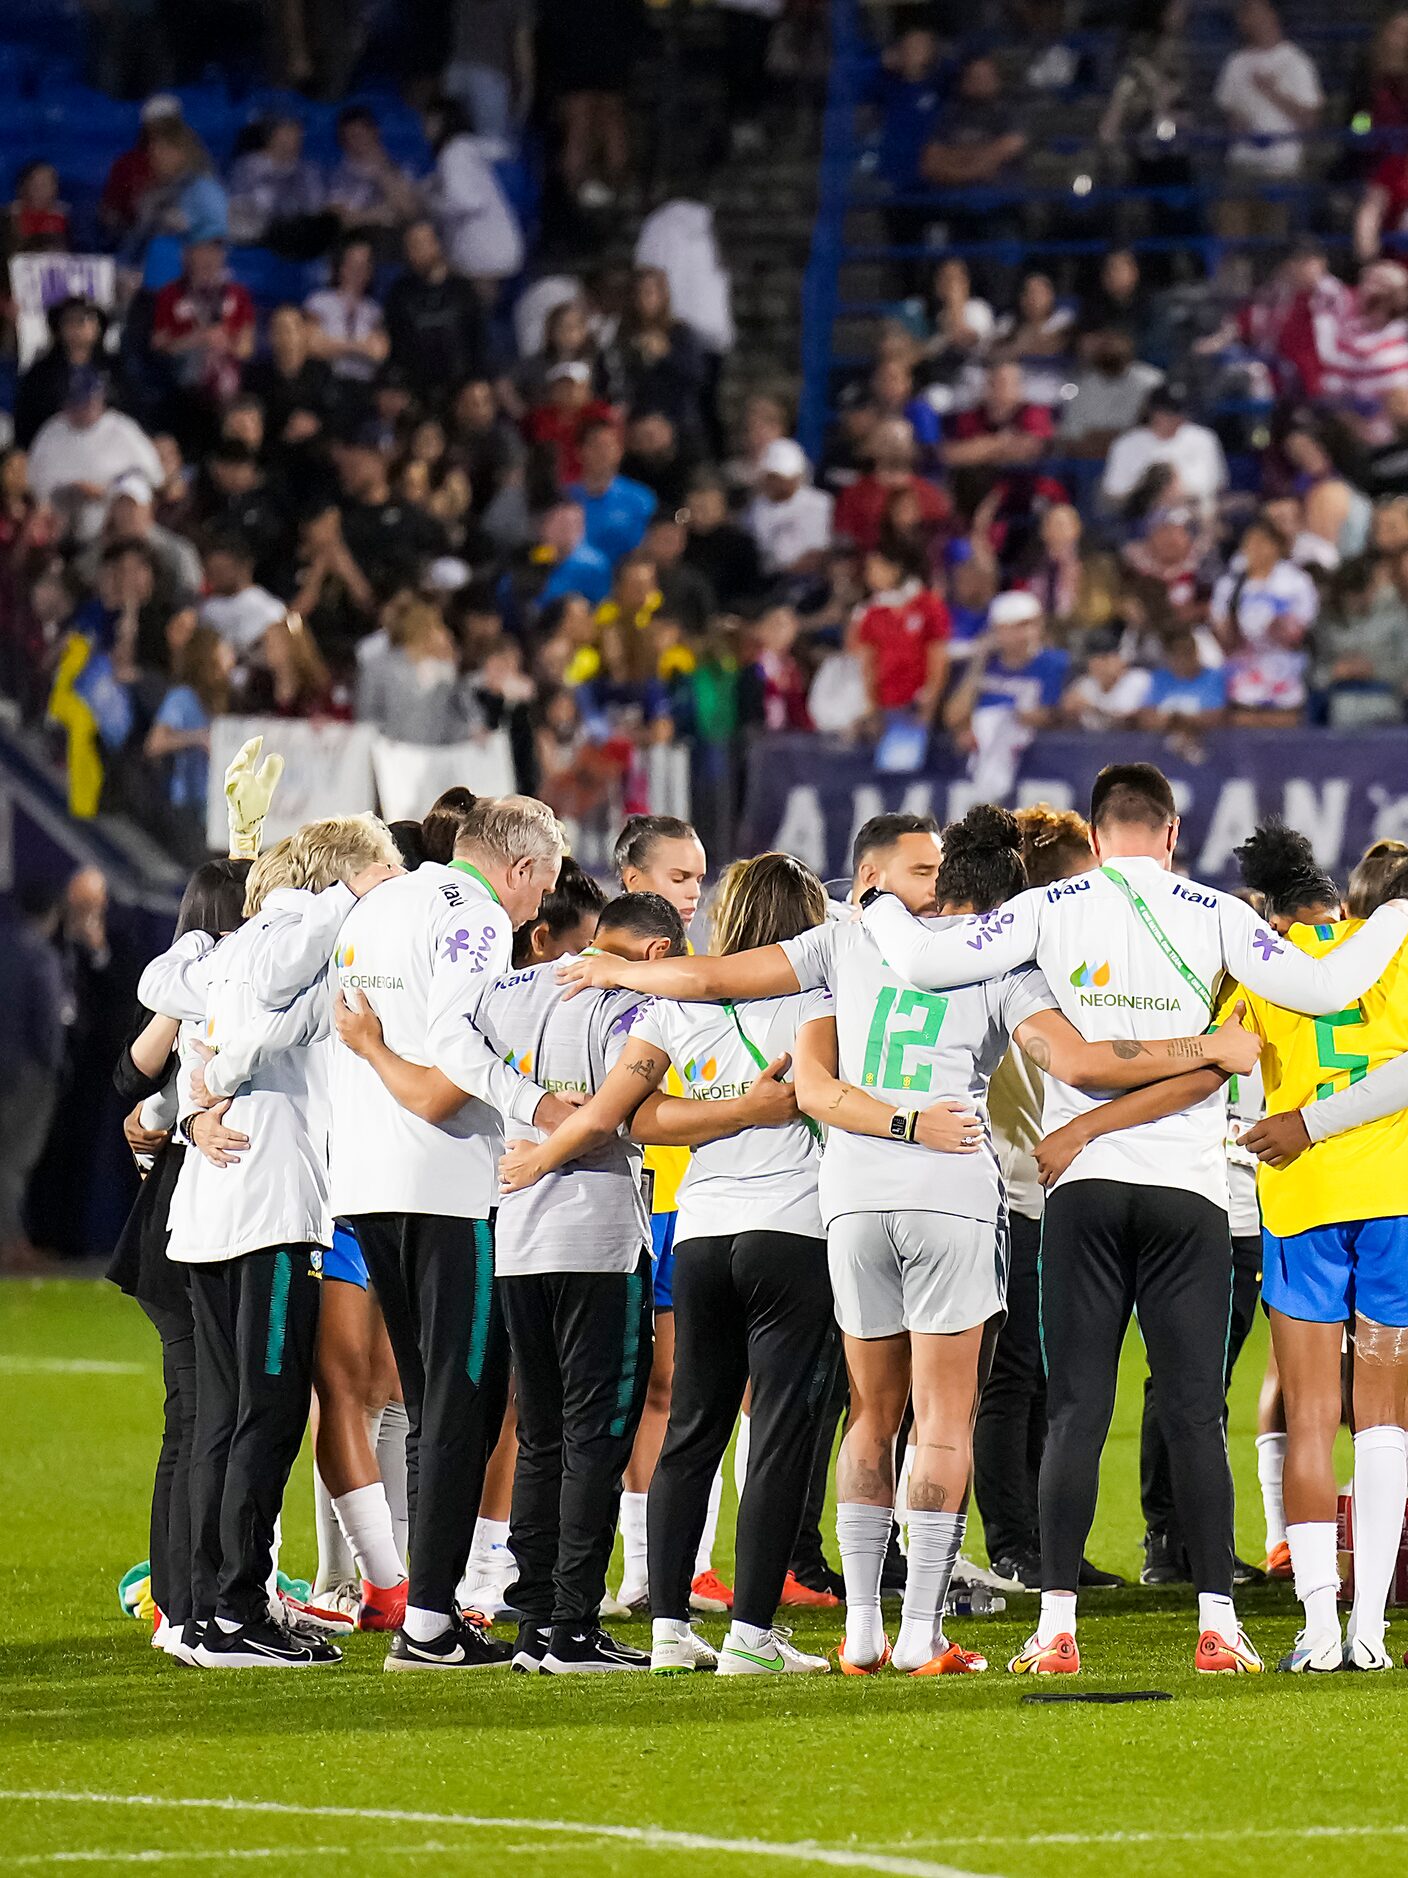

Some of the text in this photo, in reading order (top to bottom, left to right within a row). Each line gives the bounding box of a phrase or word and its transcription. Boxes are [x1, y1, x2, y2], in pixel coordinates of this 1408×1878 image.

[1047, 879, 1090, 903] Itaú
[1172, 884, 1217, 908] Itaú
[967, 913, 1014, 951] vivo
[470, 926, 496, 973] vivo
[1080, 993, 1181, 1012] NEOENERGIA
[860, 985, 949, 1092] 12
[1314, 1007, 1370, 1101] 5
[692, 1080, 754, 1100] NEOENE
